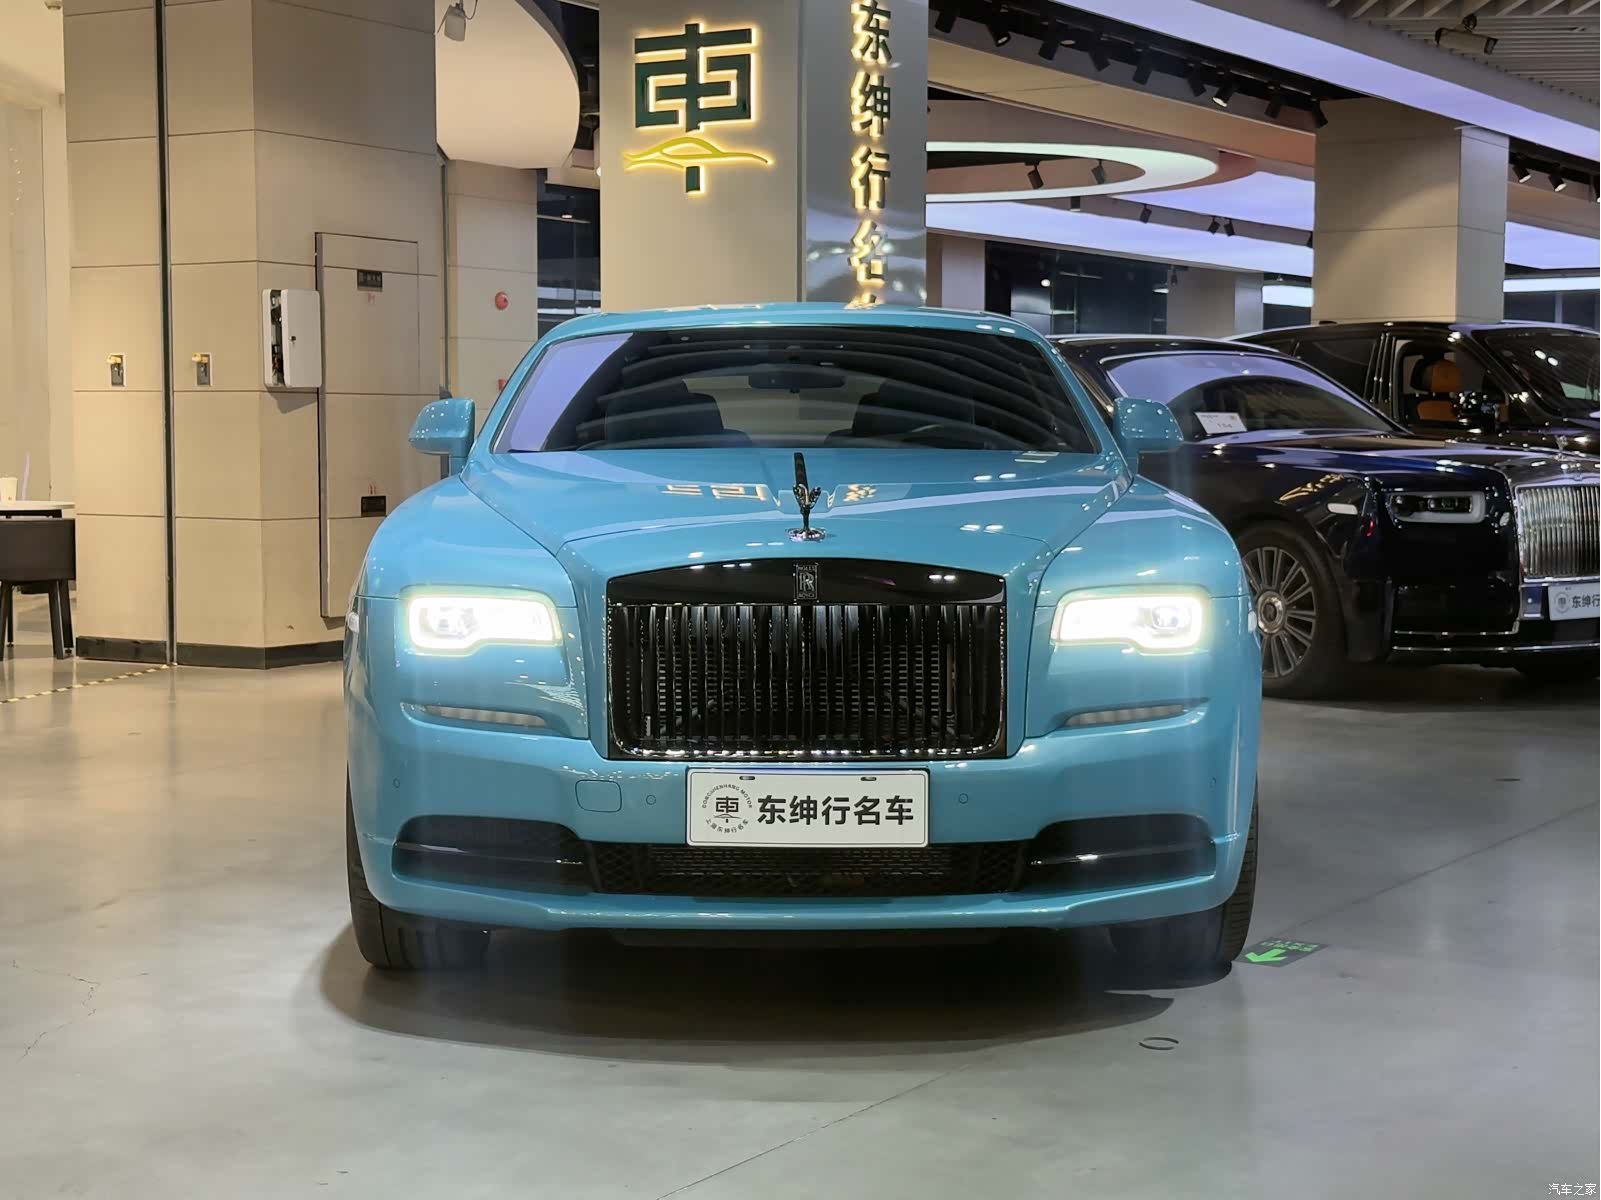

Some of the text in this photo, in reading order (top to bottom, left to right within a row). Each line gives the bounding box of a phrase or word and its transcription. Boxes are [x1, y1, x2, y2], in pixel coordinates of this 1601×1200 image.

[849, 0, 893, 308] 东绅行名
[757, 794, 914, 826] 东绅行名车
